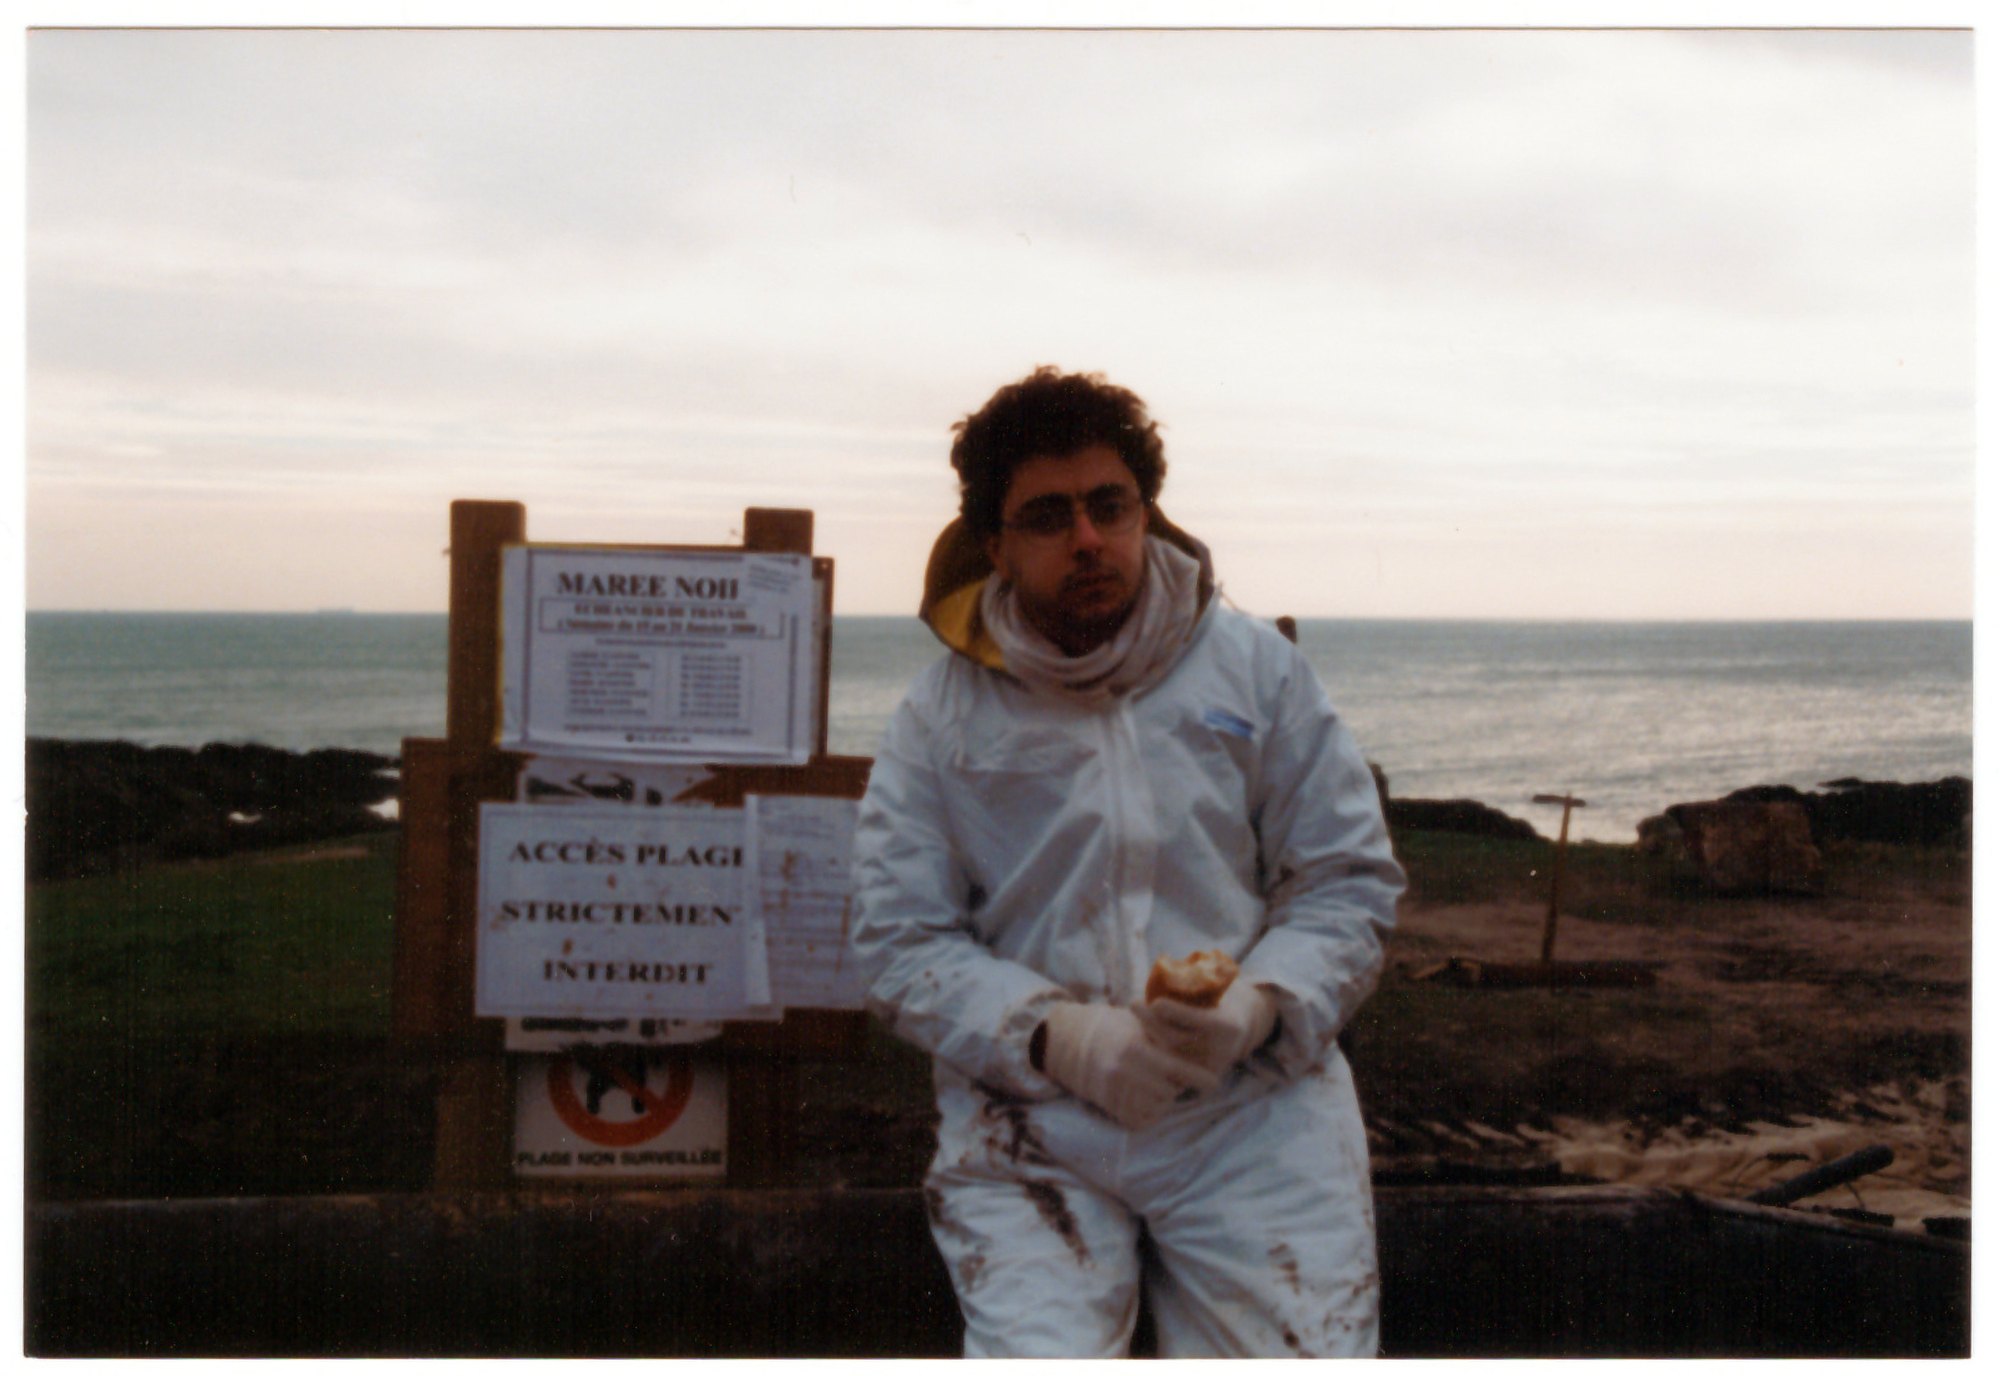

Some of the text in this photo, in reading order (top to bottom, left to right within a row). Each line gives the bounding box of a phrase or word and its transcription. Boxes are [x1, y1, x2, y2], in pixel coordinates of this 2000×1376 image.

[558, 572, 667, 598] MAREE
[543, 959, 713, 984] INTERDIT
[517, 1151, 572, 1165] PLAGE
[577, 1151, 616, 1165] NON
